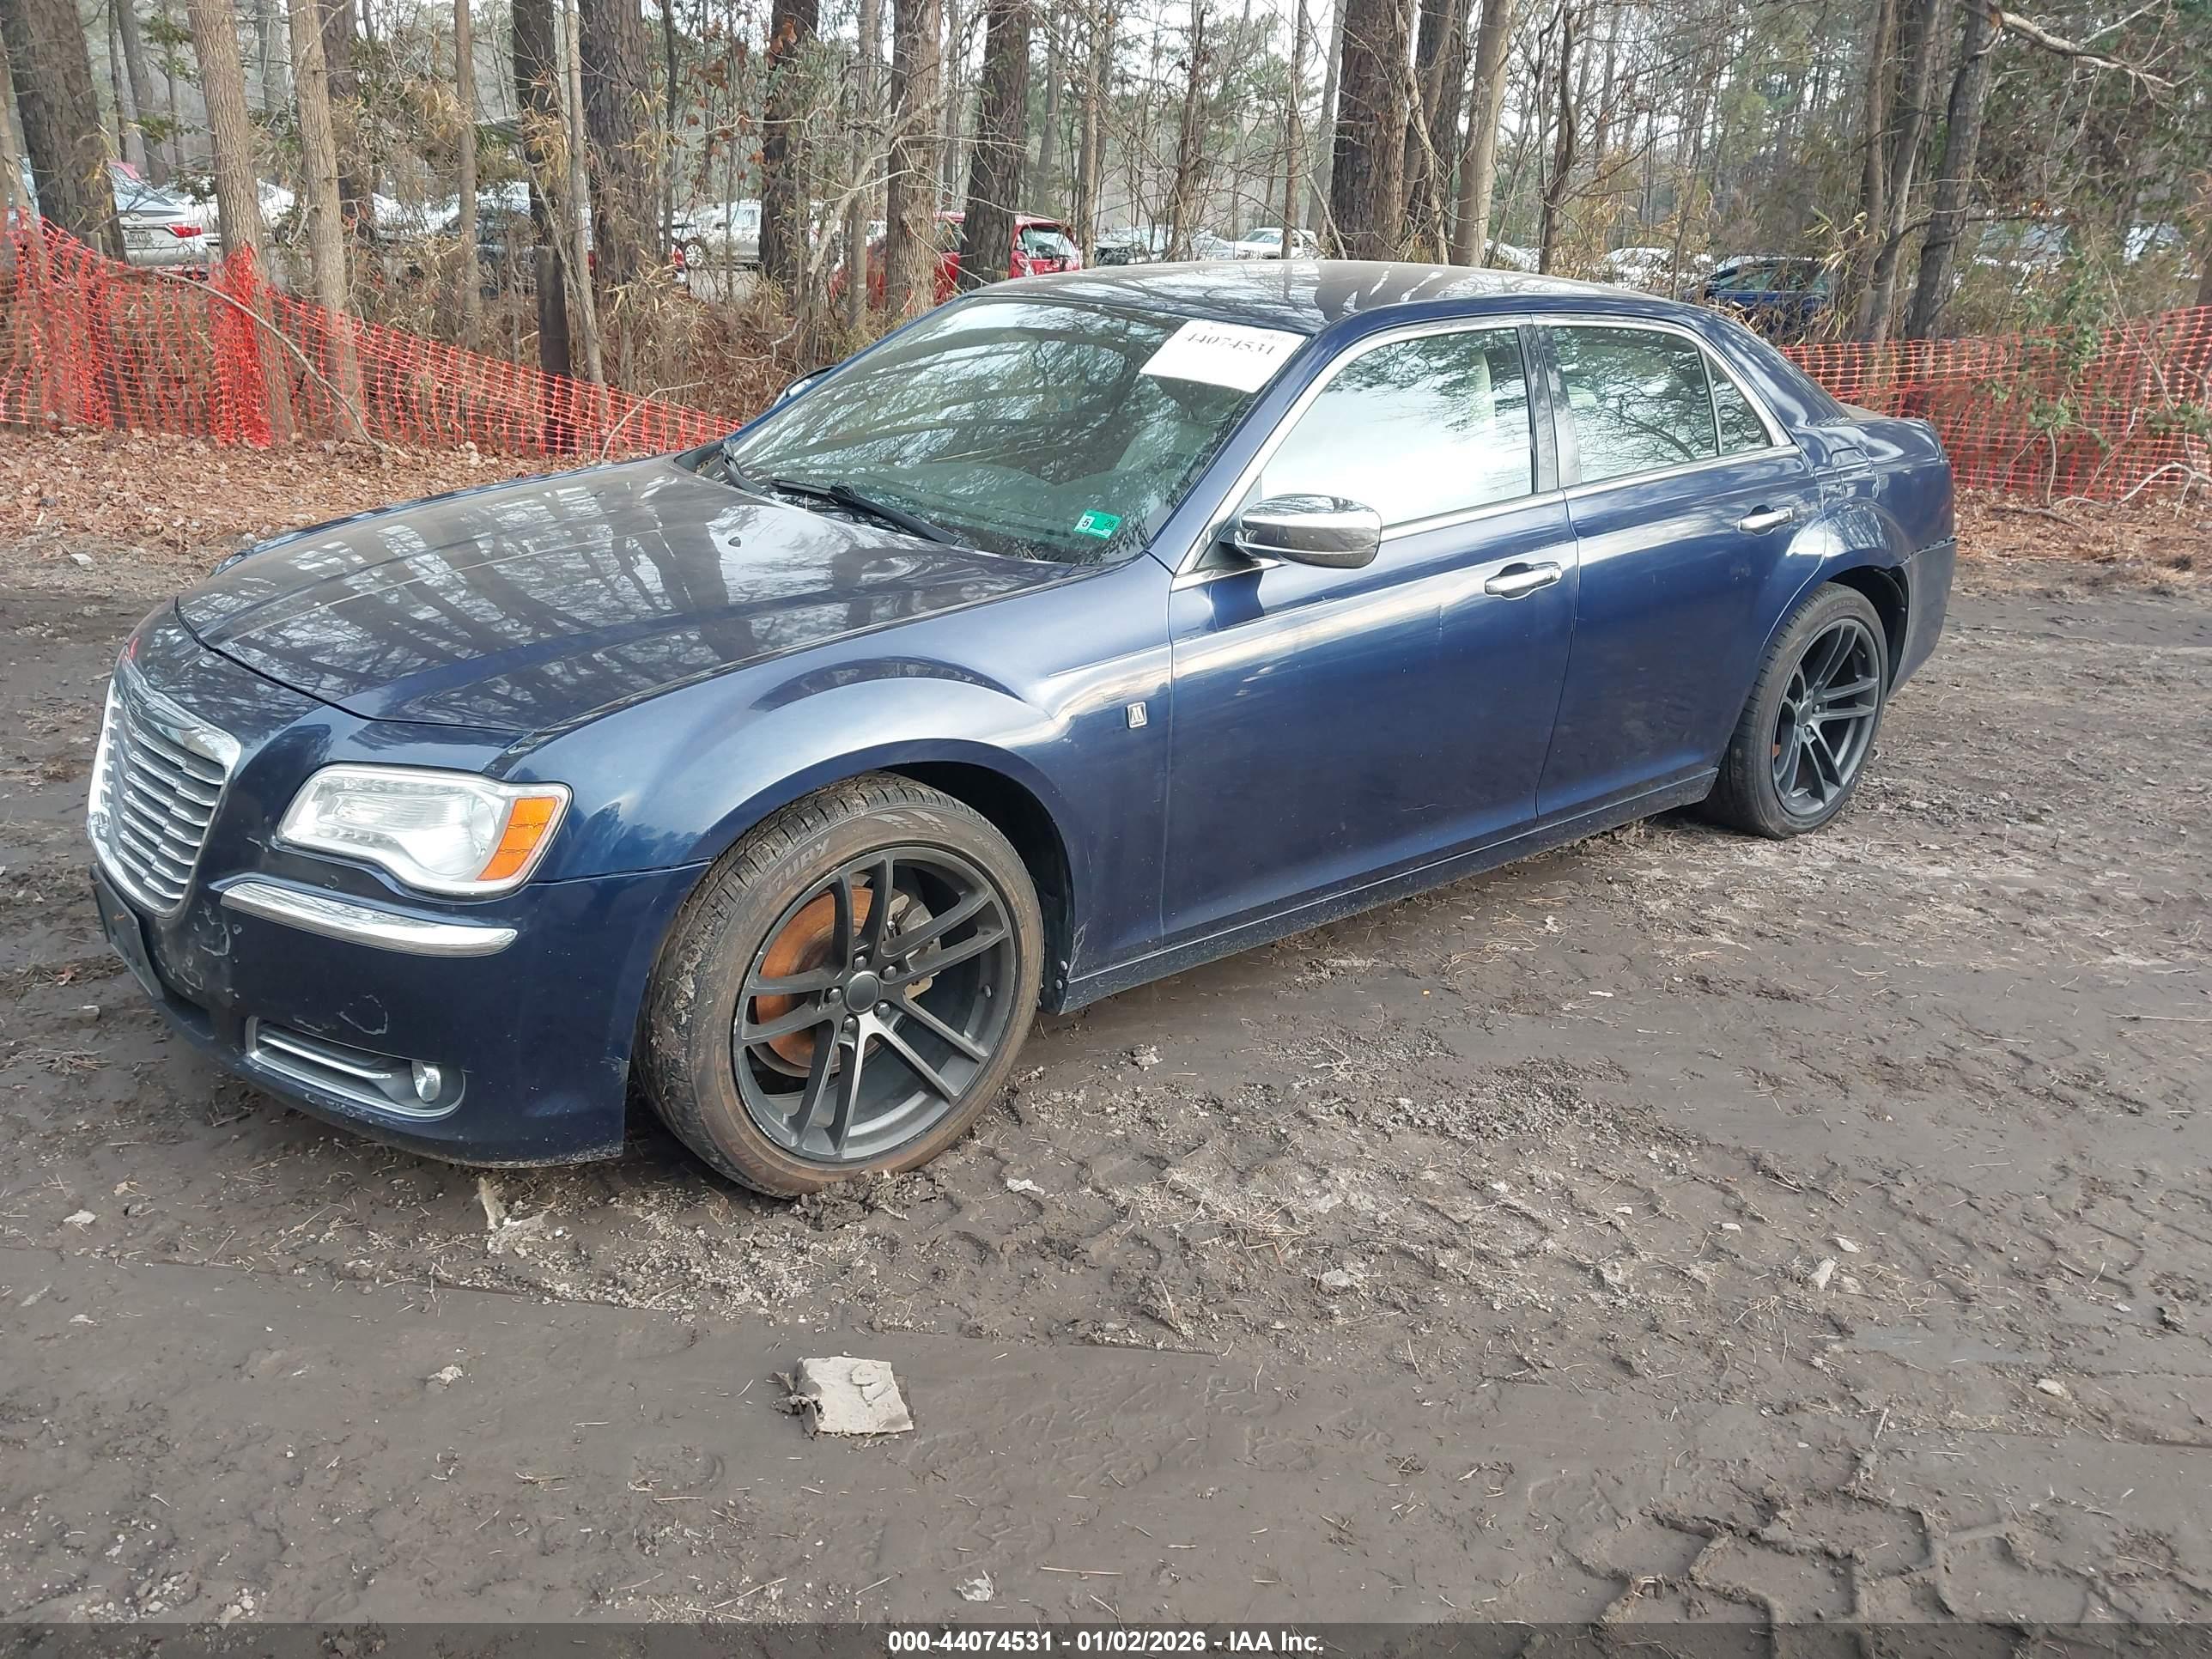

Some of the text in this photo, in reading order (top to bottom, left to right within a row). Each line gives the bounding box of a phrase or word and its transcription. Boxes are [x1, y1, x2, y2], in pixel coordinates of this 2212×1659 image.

[1185, 332, 1275, 355] 44074531
[1082, 518, 1115, 528] 5 26
